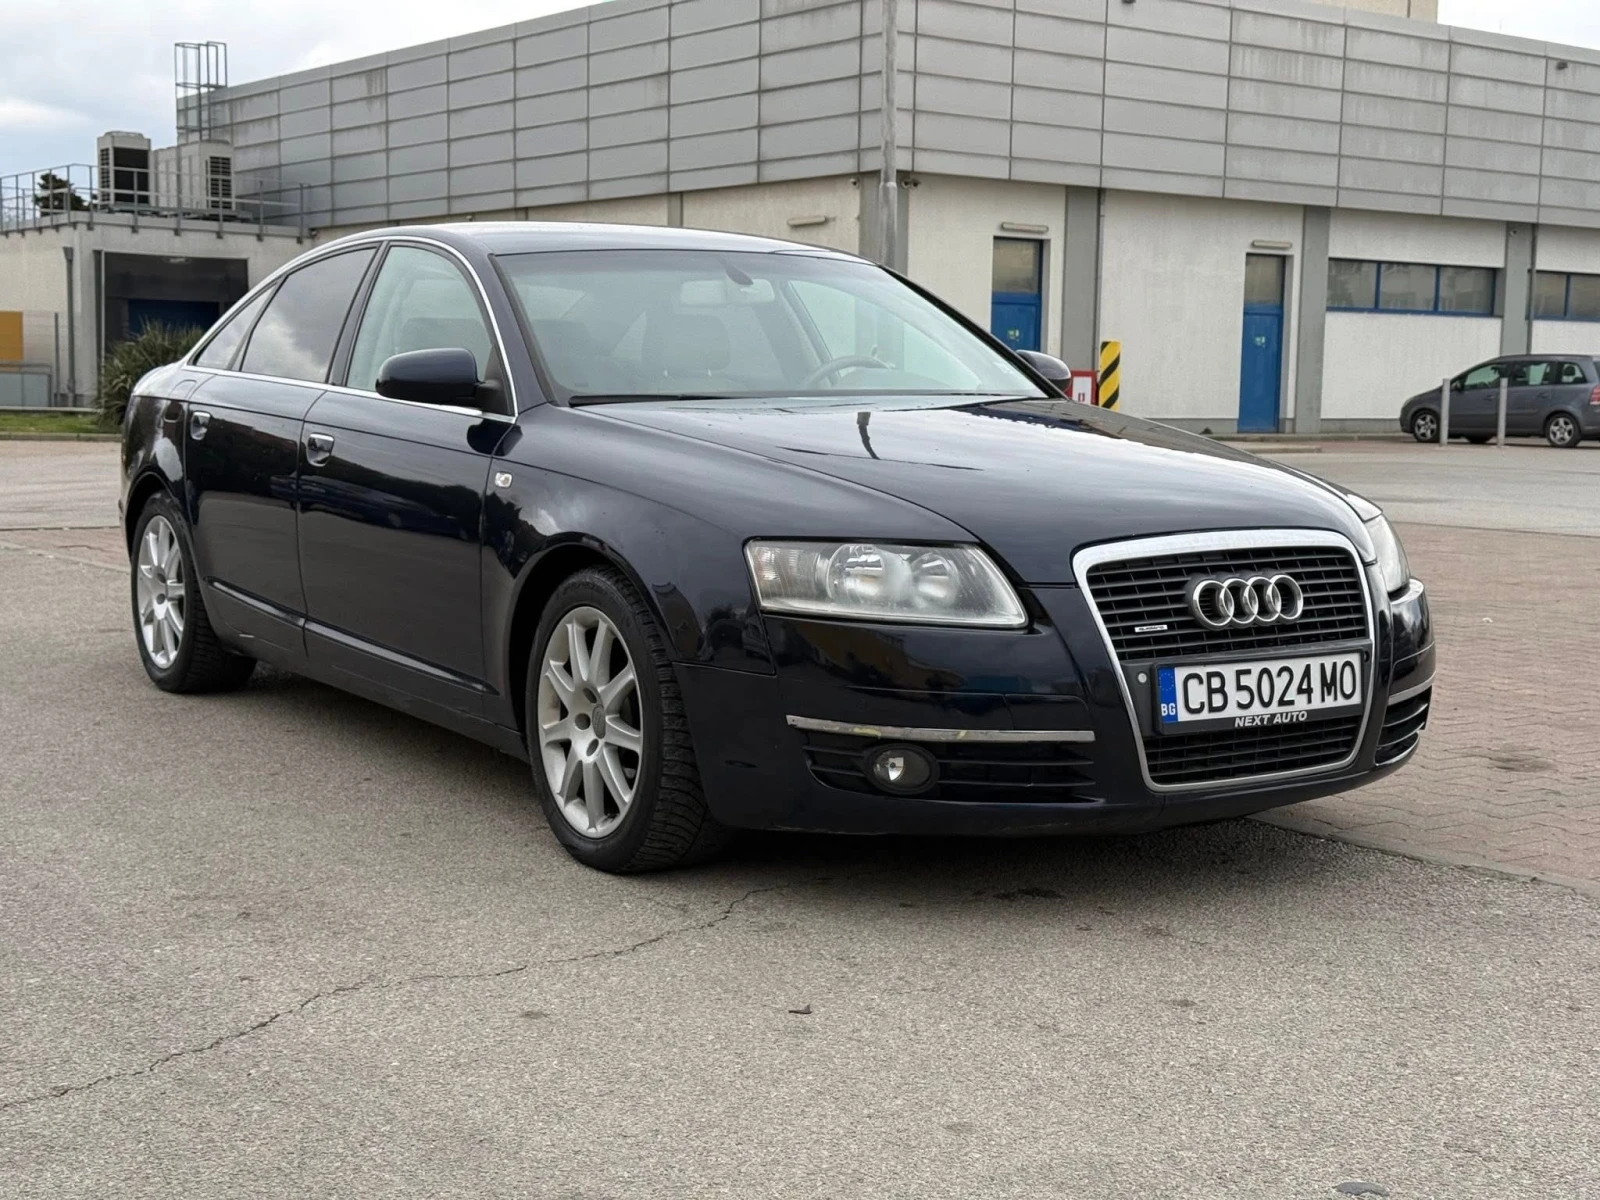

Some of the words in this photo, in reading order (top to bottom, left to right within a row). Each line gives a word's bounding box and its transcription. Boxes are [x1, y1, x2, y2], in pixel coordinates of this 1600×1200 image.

[1161, 703, 1176, 716] BG
[1235, 714, 1270, 727] NEXT
[1273, 711, 1307, 724] AUTO
